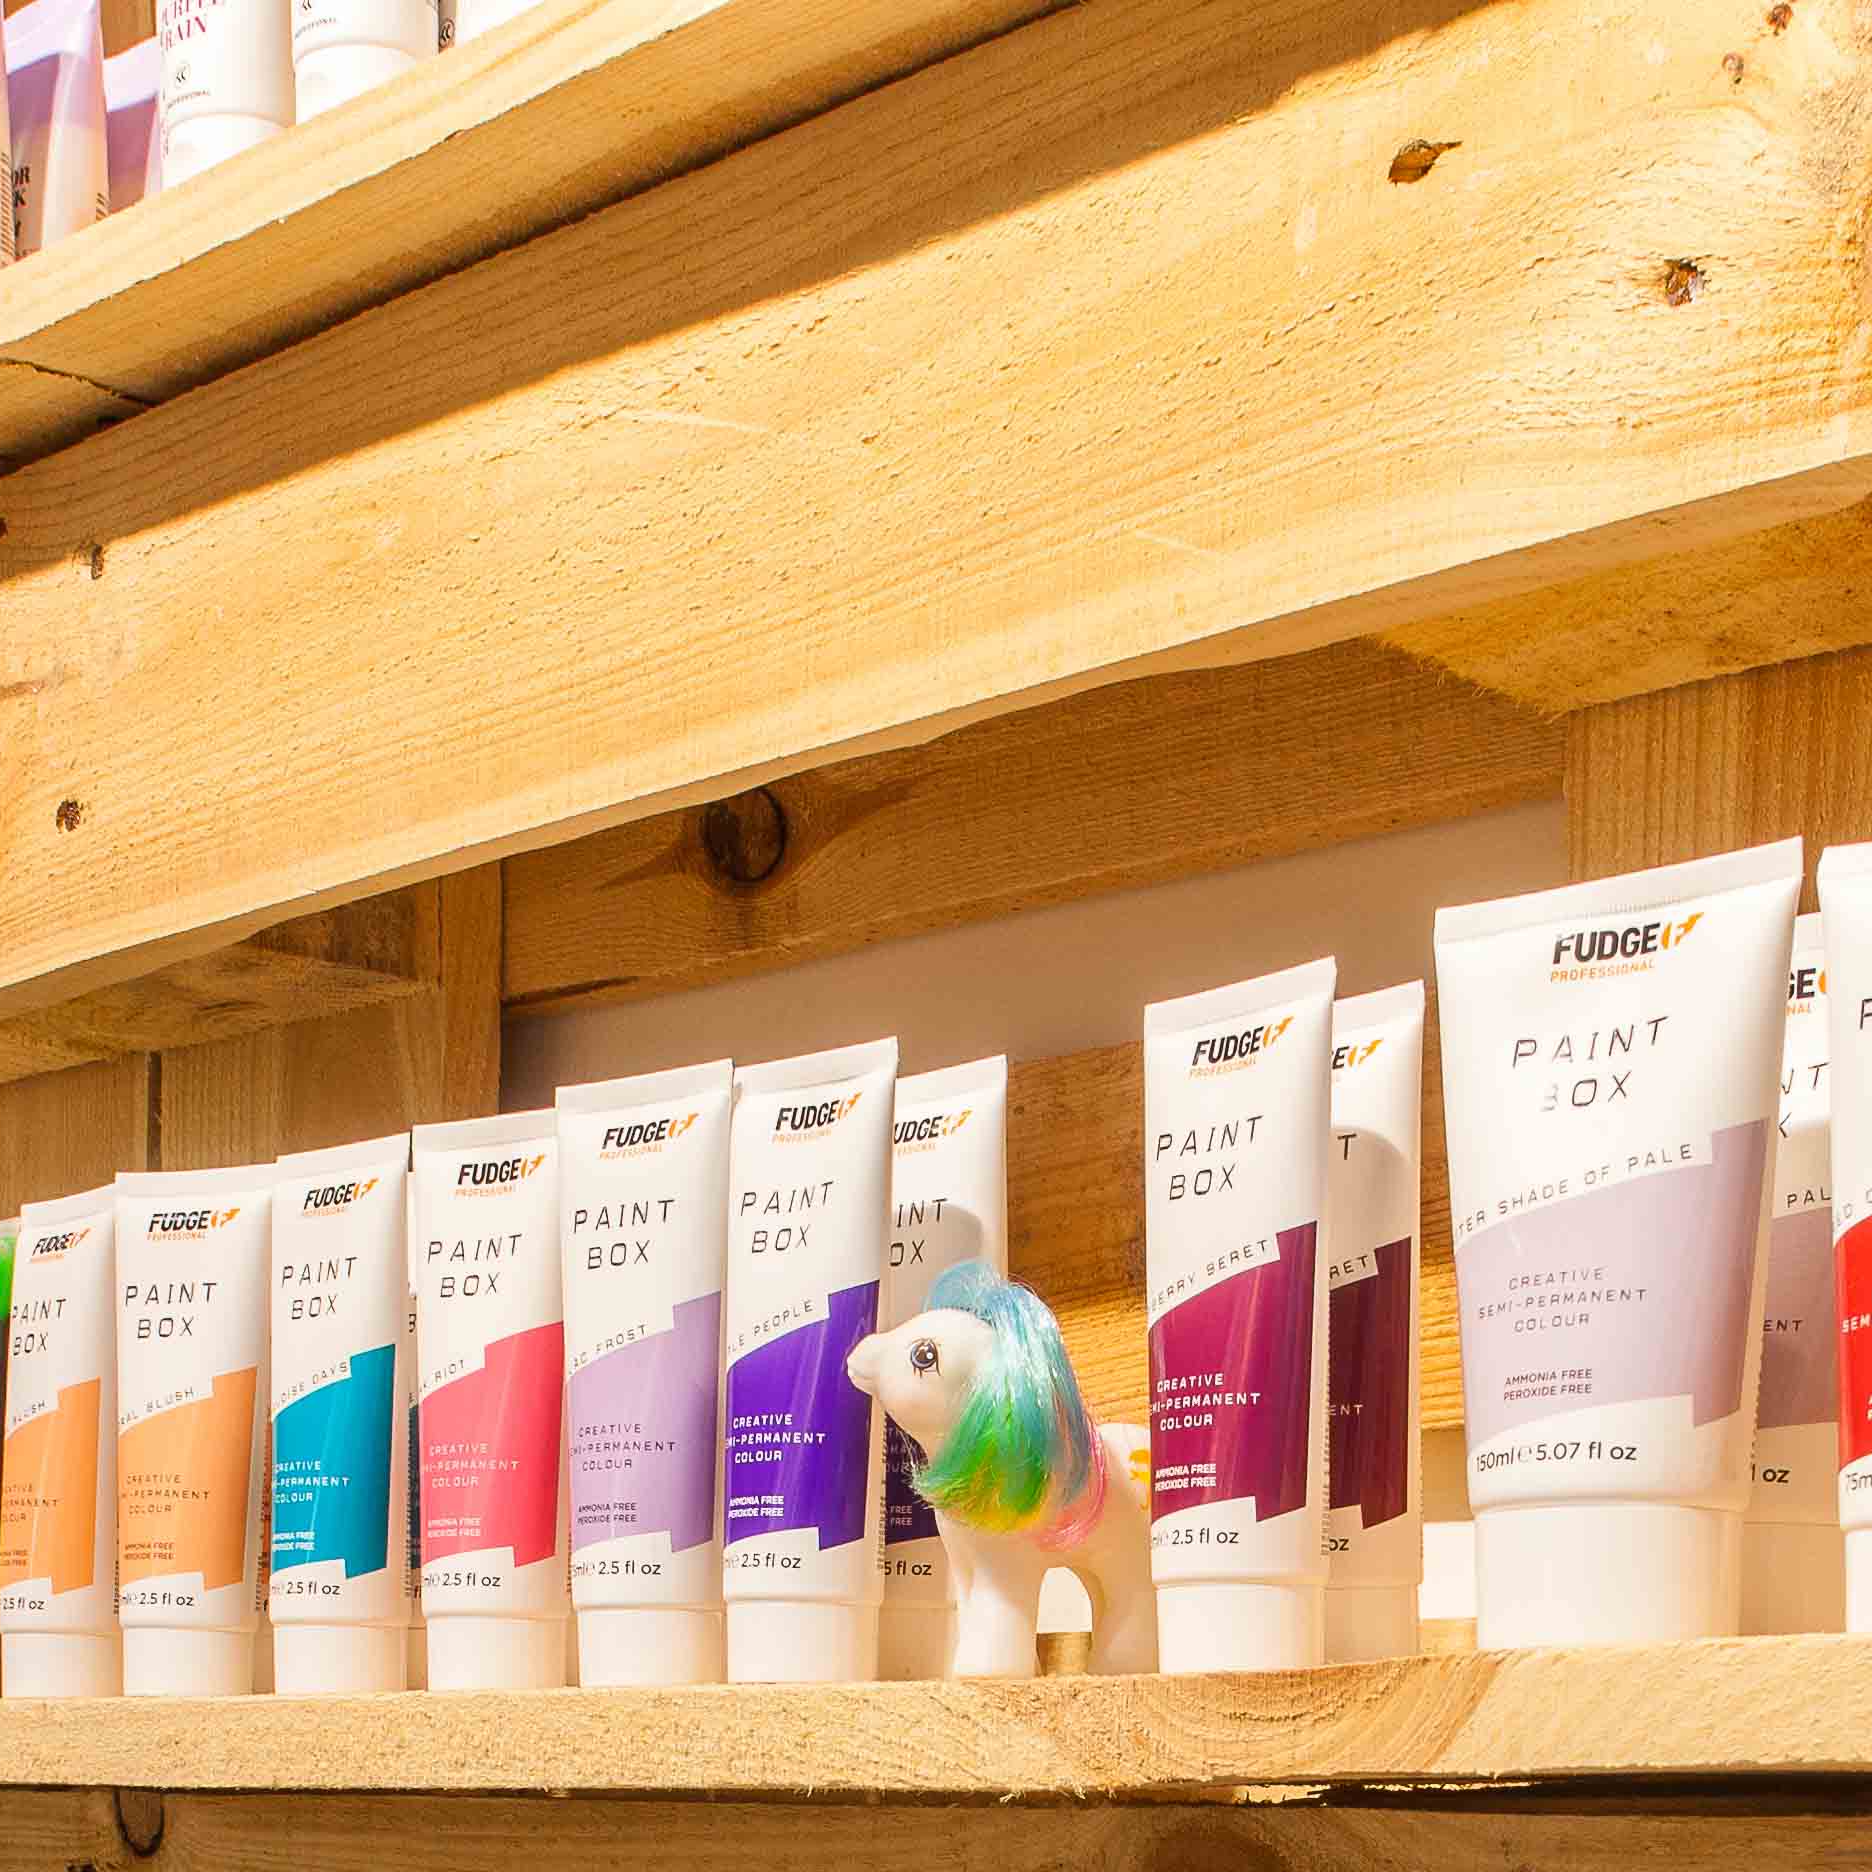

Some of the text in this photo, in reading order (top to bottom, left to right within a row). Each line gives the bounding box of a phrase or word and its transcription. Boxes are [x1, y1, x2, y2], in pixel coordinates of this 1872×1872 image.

[1552, 922, 1662, 965] FUDGE
[1550, 959, 1656, 983] PROFESSIONAL
[1192, 1025, 1264, 1066] FUDGE
[1512, 1015, 1669, 1070] PAINT
[776, 1100, 839, 1131] FUDGE
[602, 1118, 669, 1150] FUDGE
[893, 1115, 943, 1145] UDGE
[1156, 1115, 1264, 1161] PAINT
[458, 1158, 521, 1186] FUDGE
[1168, 1163, 1236, 1201] BOX
[1498, 1143, 1694, 1216] SHADE OF PALE
[303, 1182, 356, 1210] FUDGE
[741, 1181, 834, 1217] PAINT
[148, 1210, 211, 1232] FUDGE
[573, 1199, 676, 1234] PAINT
[32, 1231, 71, 1256] FUDGE
[427, 1233, 522, 1265] PAINT
[751, 1224, 811, 1254] BOX
[587, 1240, 650, 1270] BOX
[1206, 1238, 1269, 1276] BERET
[281, 1256, 358, 1288] PAINT
[440, 1272, 500, 1298] BOX
[1508, 1267, 1606, 1291] CREATIVE
[124, 1282, 216, 1307] PAINT
[291, 1294, 337, 1321] BOX
[1478, 1288, 1648, 1319] SEMI-PERMANENT
[137, 1316, 195, 1339] BOX
[753, 1300, 813, 1336] PEOPLE
[1513, 1312, 1590, 1334] COLOUR
[12, 1333, 49, 1356] BOX
[596, 1324, 647, 1352] FROST
[1157, 1373, 1224, 1393] CREATIVE
[1504, 1367, 1593, 1387] AMMONIA FREE
[1503, 1383, 1593, 1402] PEROXIDE FREE
[579, 1424, 641, 1437] CREATIVE
[733, 1413, 793, 1430] CREATIVE
[1160, 1414, 1214, 1432] COLOUR
[735, 1450, 783, 1464] COLOUR
[1535, 1441, 1580, 1463] 5.07
[1588, 1441, 1602, 1460] fl
[1610, 1445, 1638, 1462] oz
[582, 1460, 632, 1471] COLOUR
[1191, 1464, 1217, 1474] FREE
[1191, 1477, 1217, 1487] FREE
[1172, 1528, 1240, 1545] 2.5 fl oz
[741, 1552, 801, 1569] 2.5 fl oz
